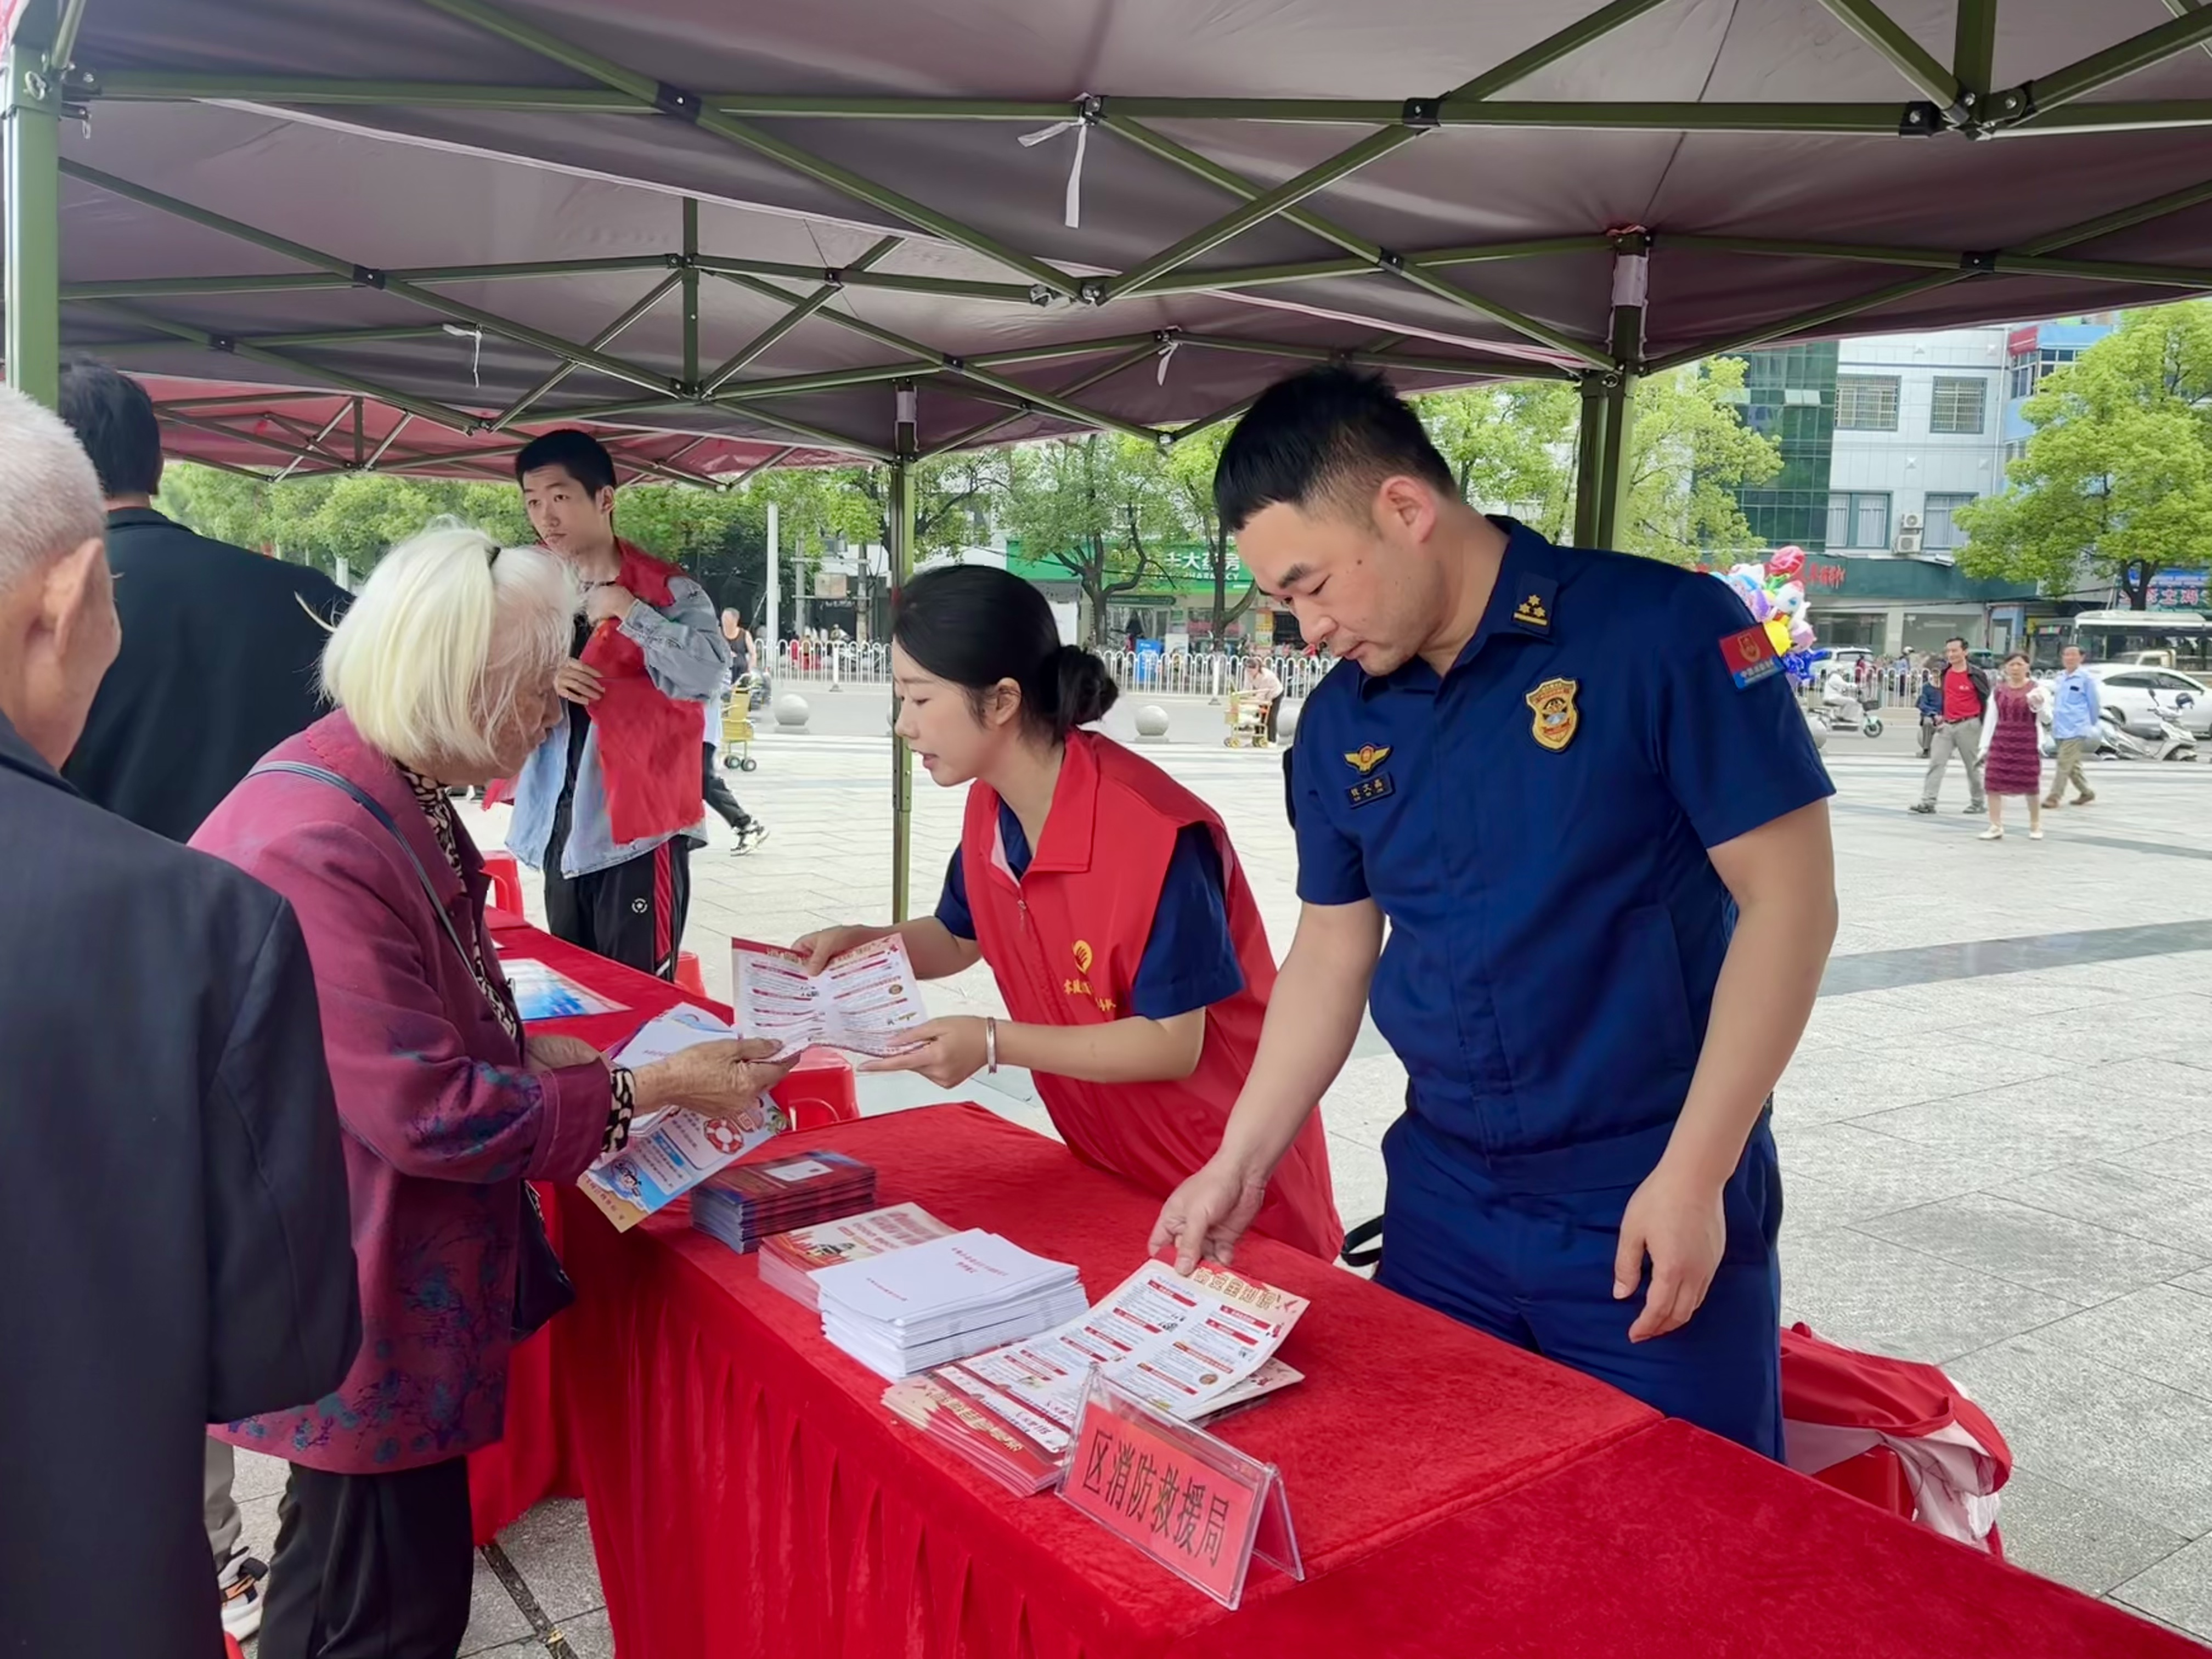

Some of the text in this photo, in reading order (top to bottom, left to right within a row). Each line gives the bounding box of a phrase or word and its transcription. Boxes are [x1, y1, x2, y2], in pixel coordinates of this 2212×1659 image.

[1083, 1429, 1229, 1567] 区消防救援局
